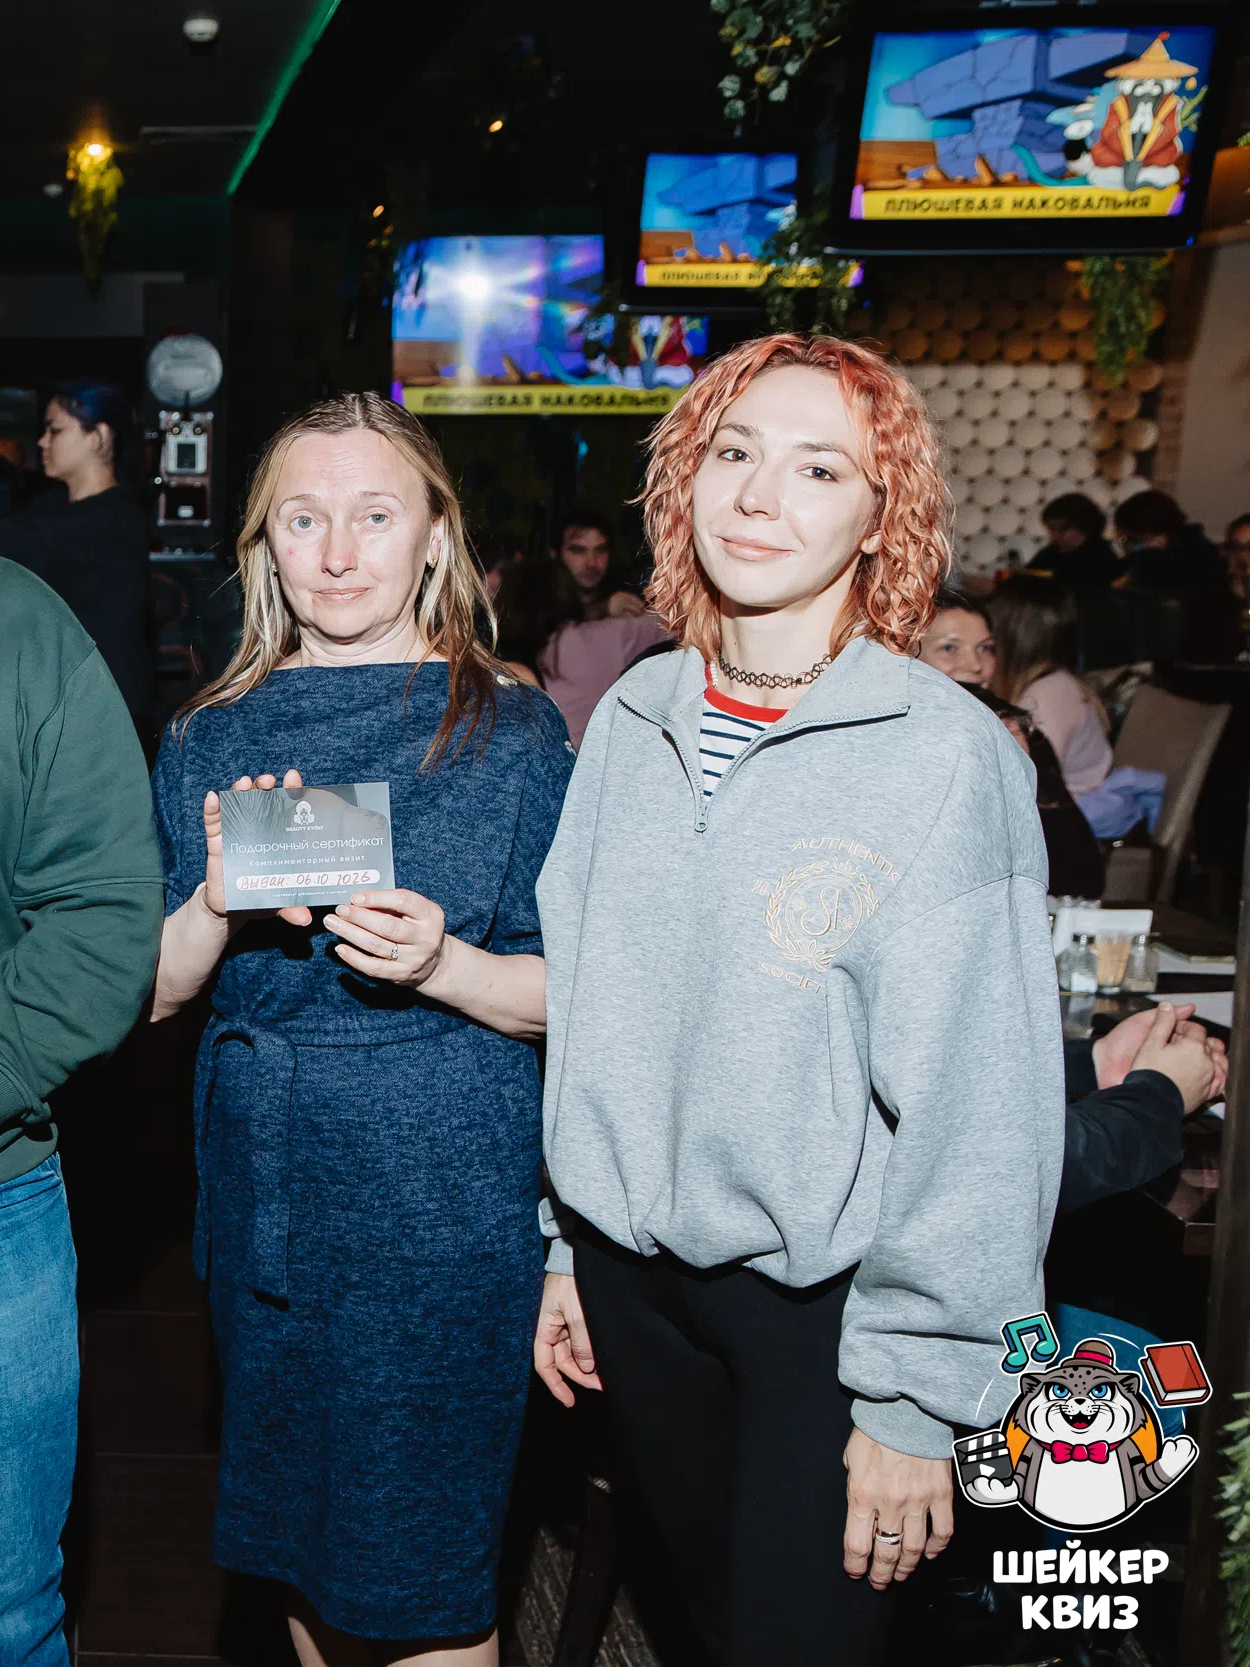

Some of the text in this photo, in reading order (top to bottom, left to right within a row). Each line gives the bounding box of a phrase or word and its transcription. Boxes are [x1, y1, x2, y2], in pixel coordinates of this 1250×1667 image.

[884, 194, 1151, 213] ПЛЮШЕВАЯ НАКОВАЛЬНЯ
[230, 835, 385, 854] Подарочный сертификат
[249, 855, 366, 867] Комплиментарный визит
[241, 875, 290, 890] Выдан:
[758, 962, 825, 994] SOCIET
